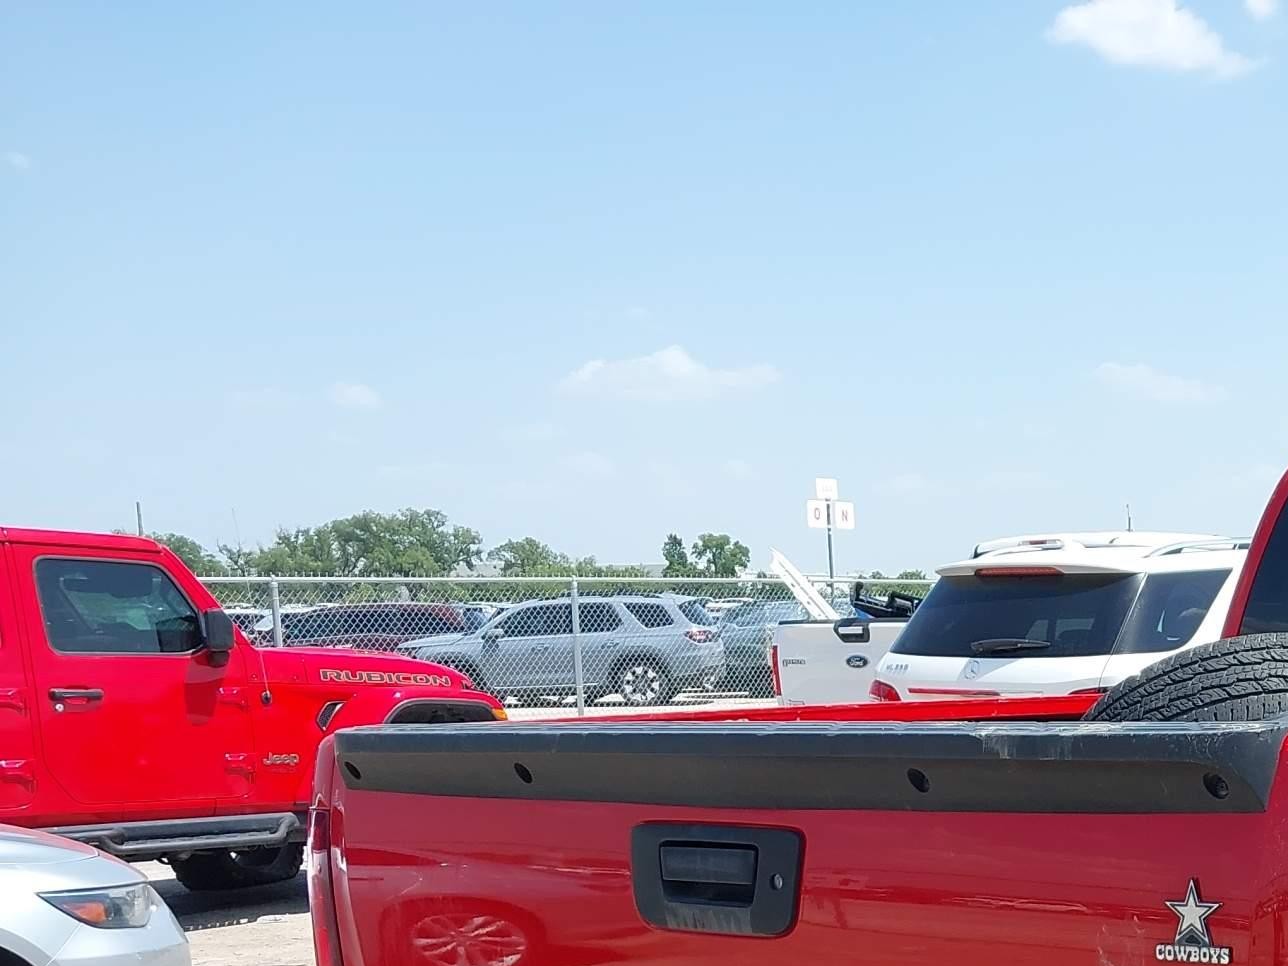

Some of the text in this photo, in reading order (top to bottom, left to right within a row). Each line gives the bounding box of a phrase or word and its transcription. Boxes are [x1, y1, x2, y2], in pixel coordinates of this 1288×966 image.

[320, 669, 451, 686] RUBICON
[263, 752, 300, 766] Jeep
[1156, 944, 1230, 965] COWBOYS
